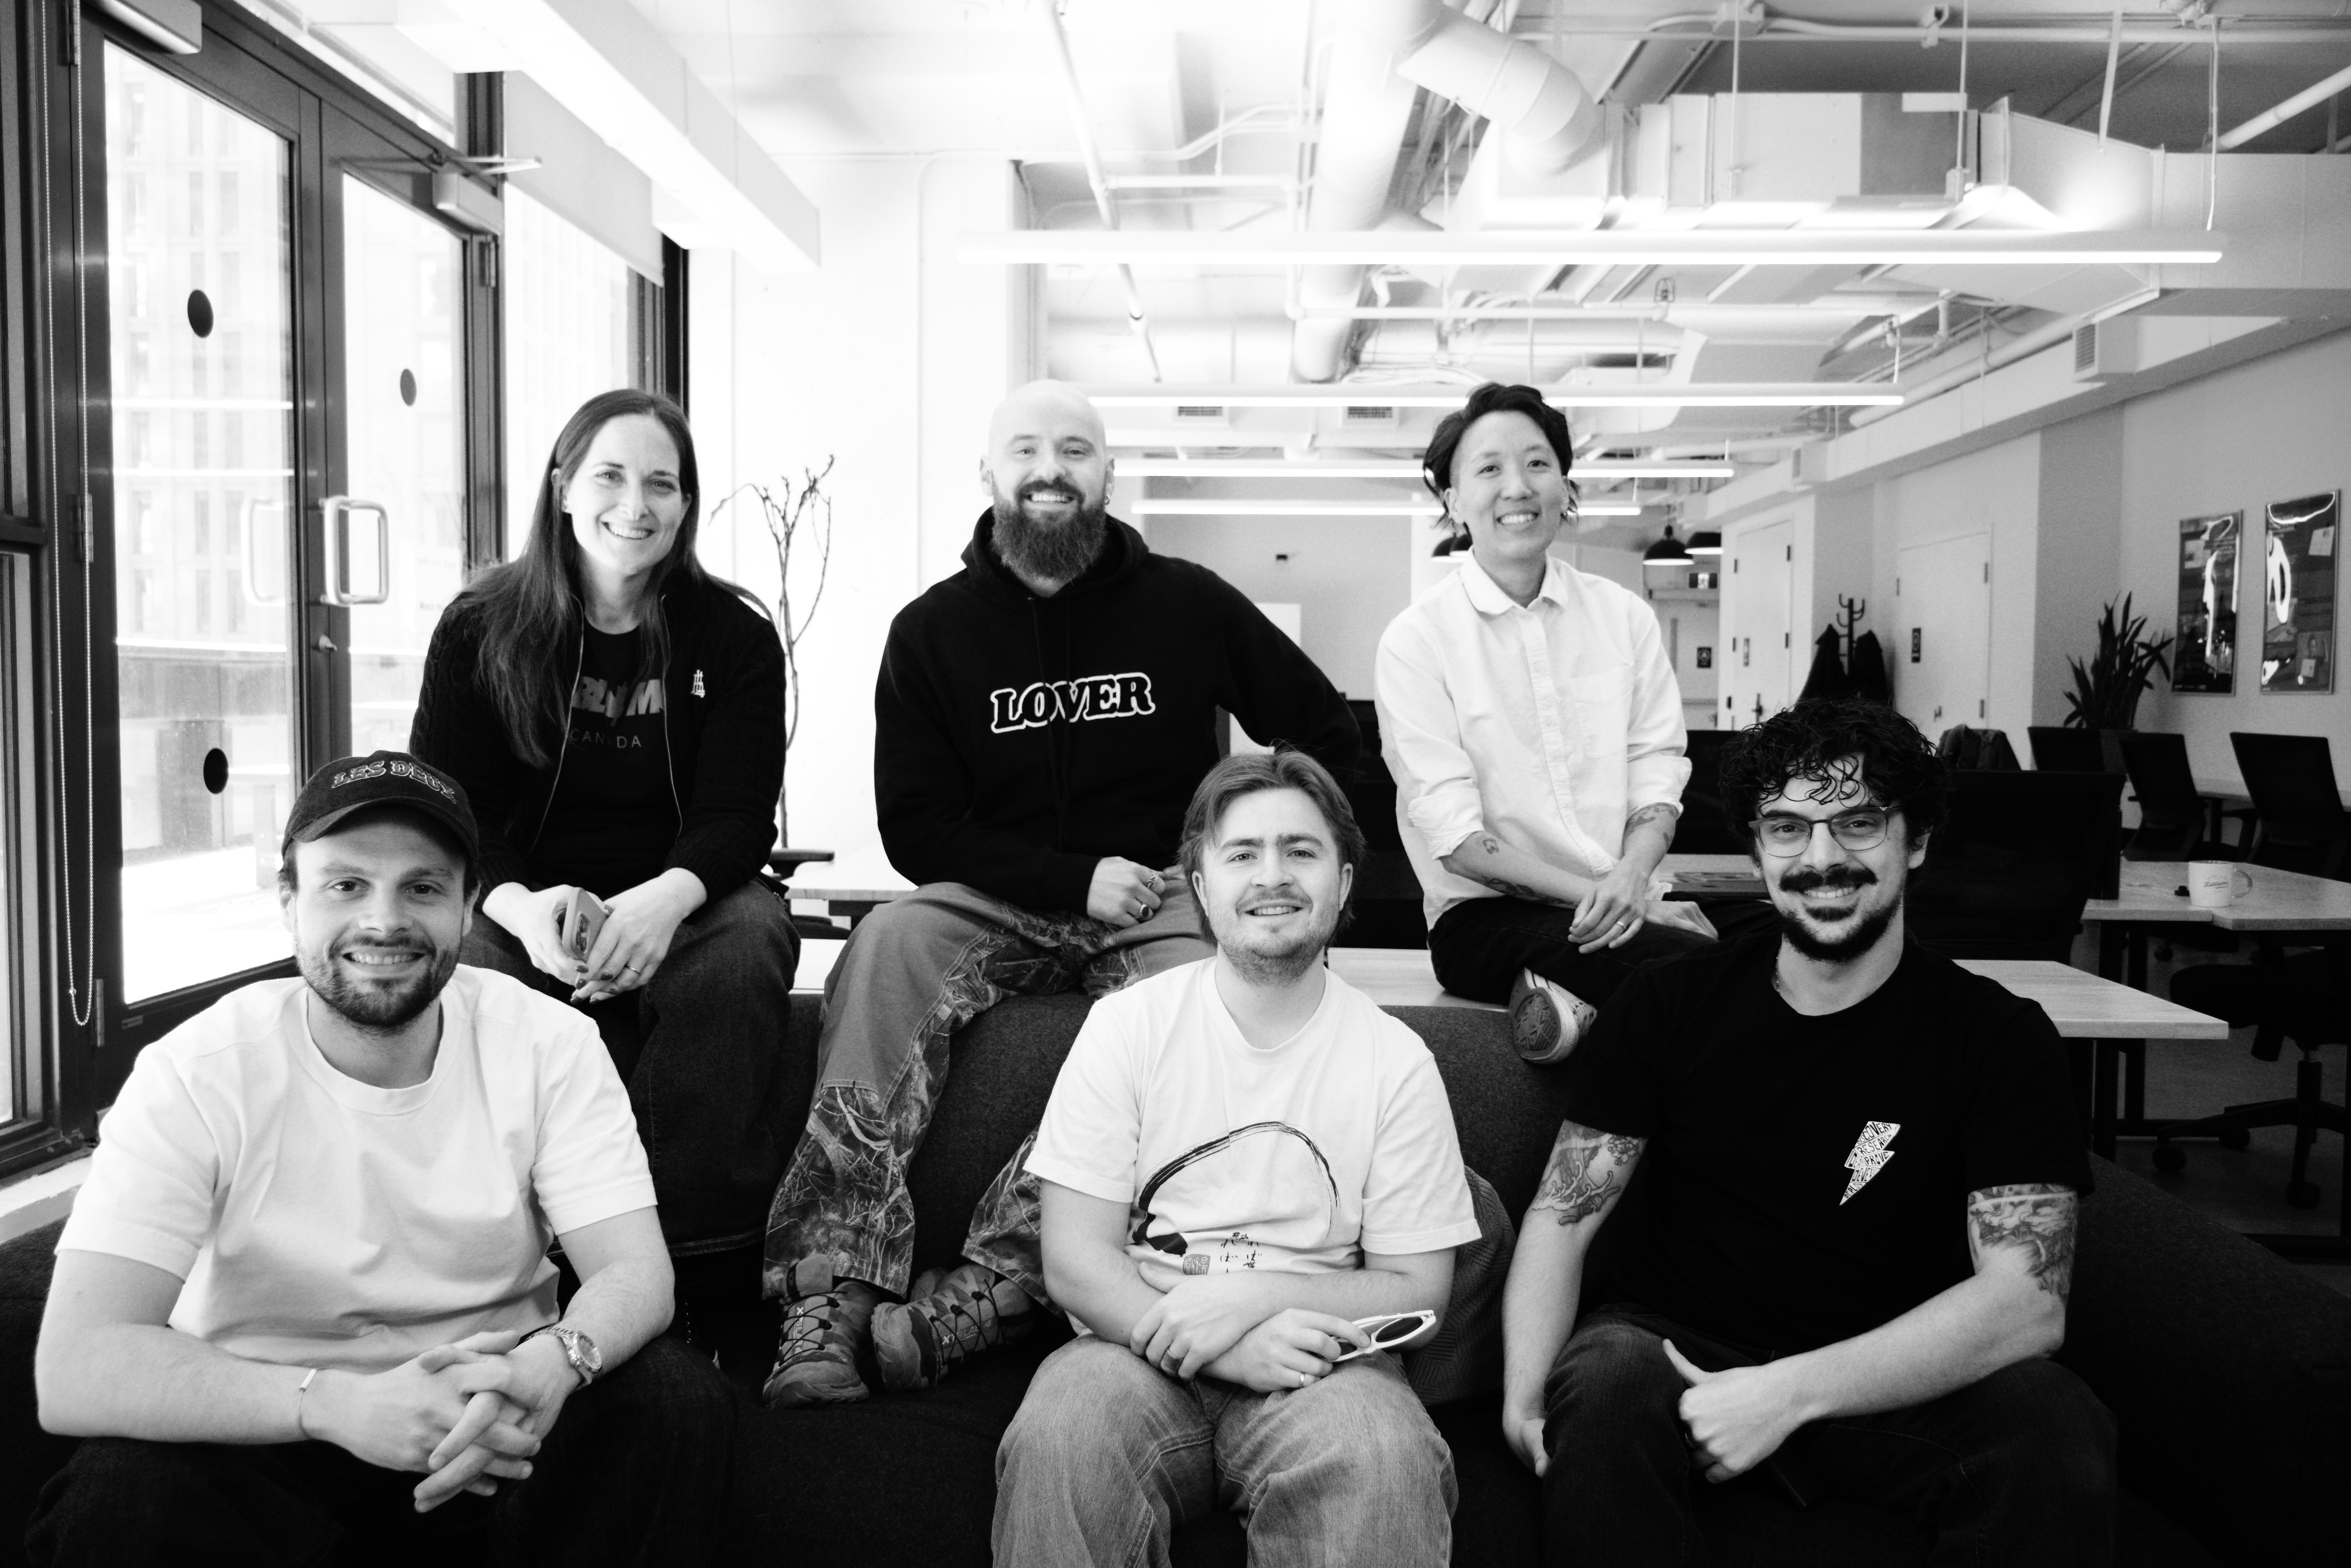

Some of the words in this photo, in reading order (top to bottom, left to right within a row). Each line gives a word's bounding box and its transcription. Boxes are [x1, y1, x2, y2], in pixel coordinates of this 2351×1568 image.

[990, 672, 1156, 734] LOVER
[332, 760, 386, 789] LES
[390, 760, 457, 804] DEUX
[1857, 1122, 1891, 1145] DISCOVERY
[1857, 1134, 1892, 1155] RESEARCH
[1864, 1151, 1889, 1165] PROVE
[1844, 1183, 1863, 1199] DEPLOY
